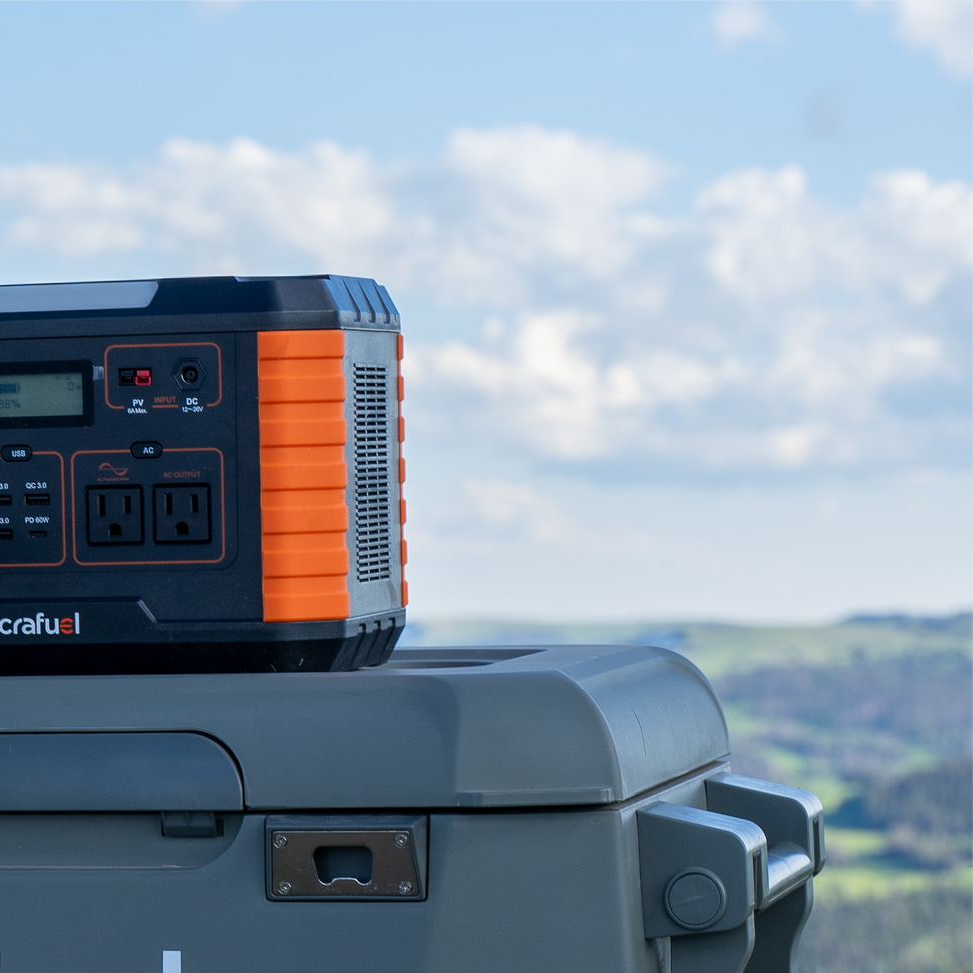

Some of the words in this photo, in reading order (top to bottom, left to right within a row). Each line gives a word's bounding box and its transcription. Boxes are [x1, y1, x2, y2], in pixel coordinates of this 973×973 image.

[132, 398, 144, 407] PV
[154, 396, 177, 404] INPUT
[186, 397, 198, 405] DC
